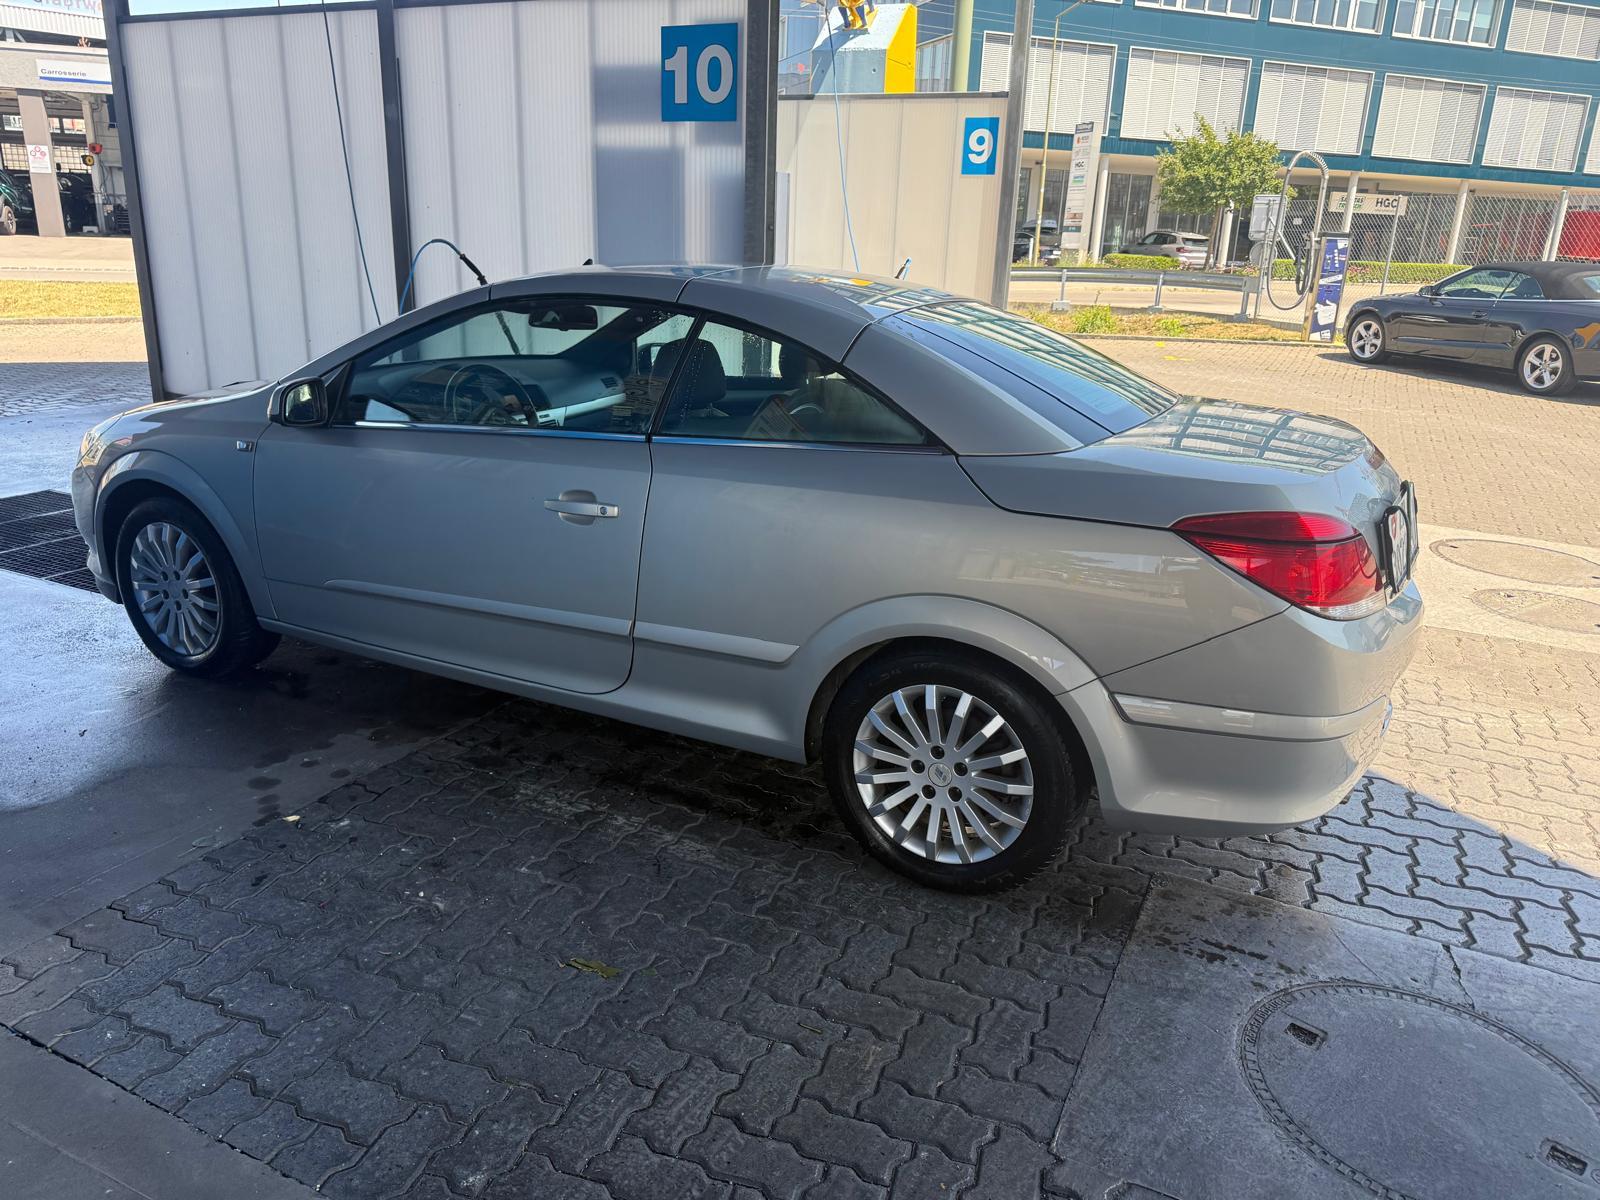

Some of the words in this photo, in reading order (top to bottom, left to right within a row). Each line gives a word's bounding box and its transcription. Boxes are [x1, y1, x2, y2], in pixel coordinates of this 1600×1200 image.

[40, 68, 87, 77] Carrosserie
[664, 43, 735, 105] 10
[967, 128, 994, 164] 9
[1376, 197, 1398, 208] HGC
